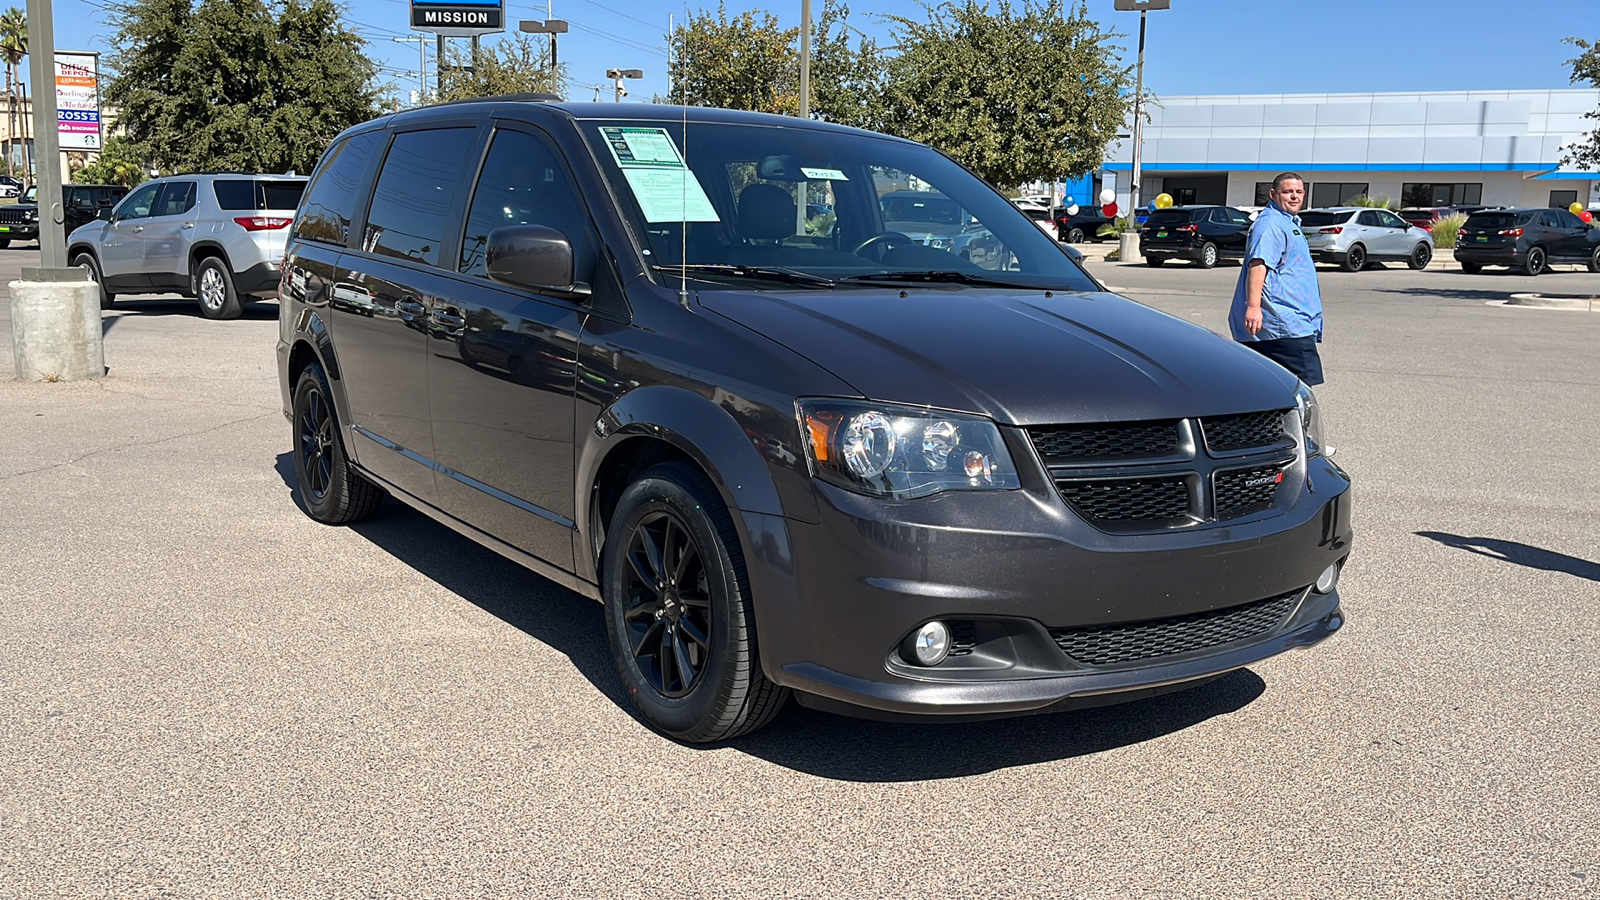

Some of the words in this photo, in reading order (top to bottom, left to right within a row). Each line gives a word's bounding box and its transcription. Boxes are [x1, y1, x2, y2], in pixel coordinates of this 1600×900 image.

[425, 11, 488, 23] MISSION
[58, 111, 88, 120] ROSS
[1245, 475, 1276, 487] DODGE
